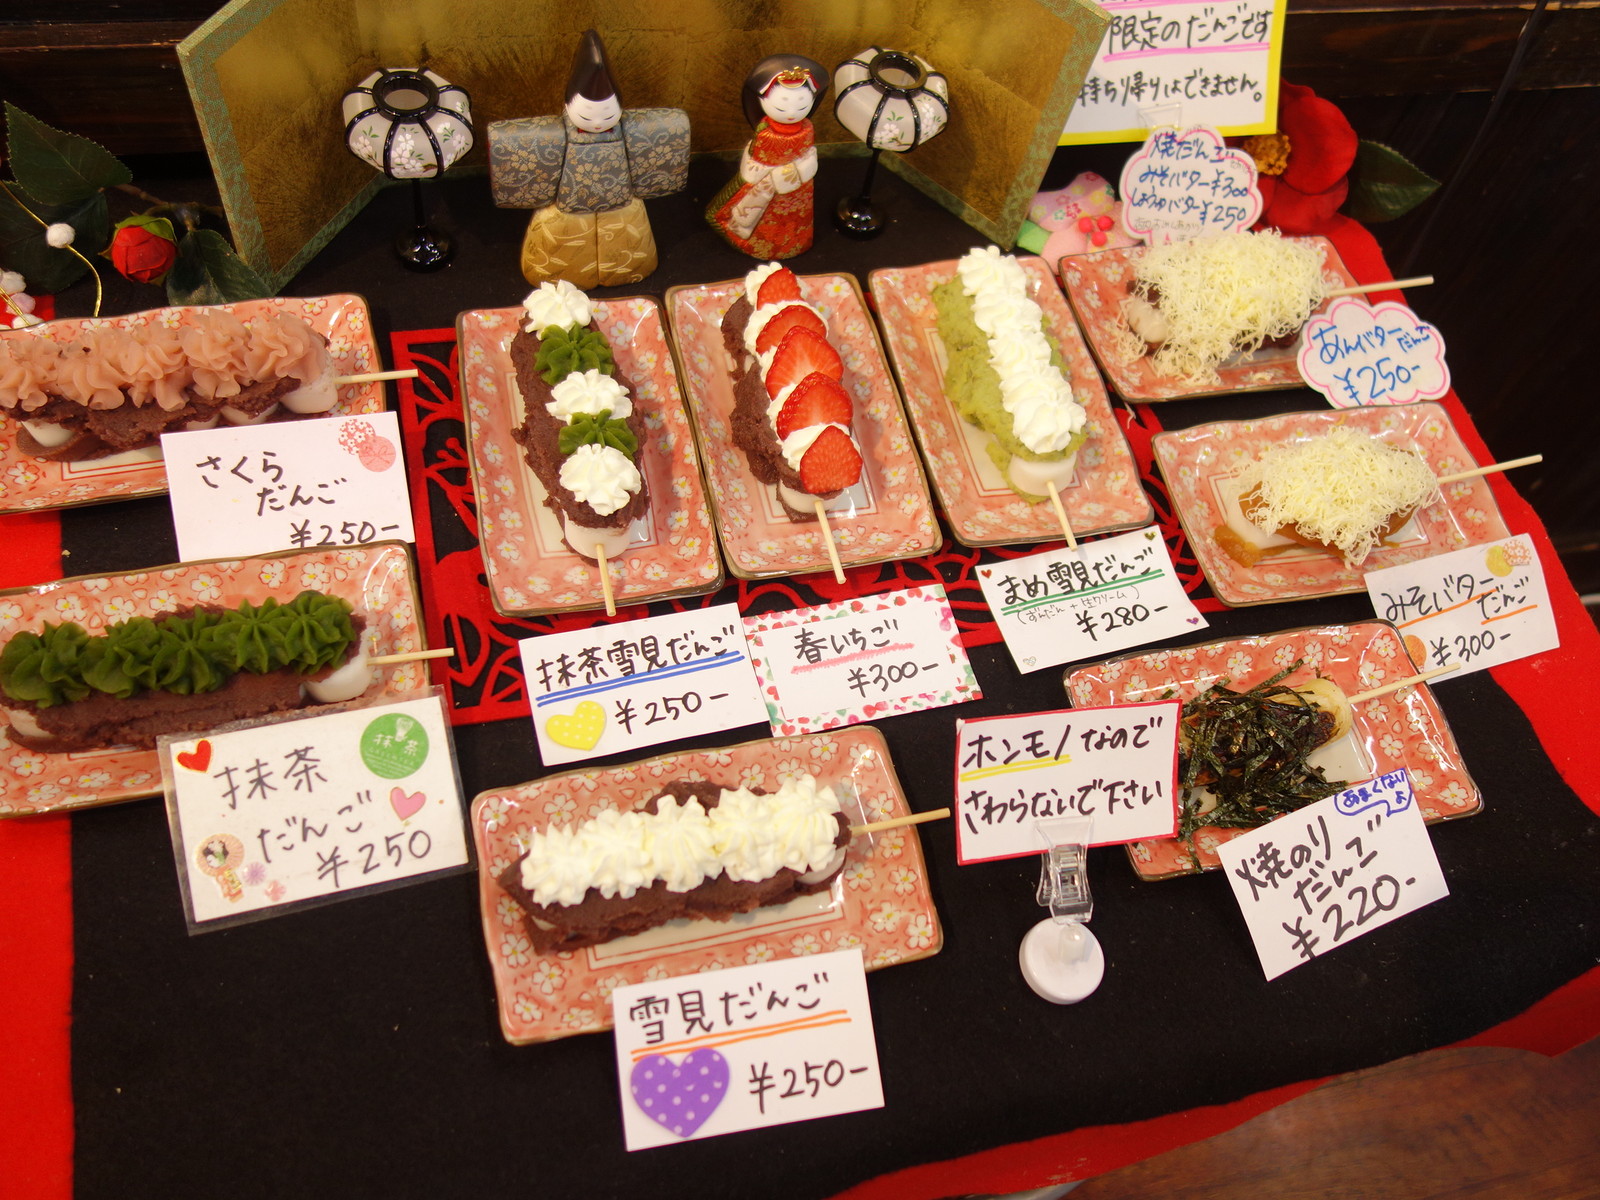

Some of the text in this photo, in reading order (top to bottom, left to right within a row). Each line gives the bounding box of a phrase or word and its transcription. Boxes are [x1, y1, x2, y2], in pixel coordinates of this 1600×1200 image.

[1109, 3, 1274, 55] 限定のだんごです
[1150, 131, 1235, 163] 焼だんご
[196, 451, 283, 488] さくら
[257, 477, 347, 516] だんご
[997, 547, 1153, 605] まめ雪見だんご
[1381, 574, 1494, 621] みそバター
[1477, 576, 1529, 620] だんご
[536, 625, 735, 692] 抹茶雪見だんご
[793, 619, 899, 663] 春いちご
[213, 745, 328, 810] 抹茶
[1342, 770, 1405, 808] あまくない
[257, 790, 372, 863] だんご
[963, 779, 1164, 834] さわらないで下さい
[316, 830, 431, 888] ¥250
[1235, 815, 1331, 901] 焼のり
[1293, 814, 1381, 915] だんご
[629, 972, 829, 1044] 雪見だんご
